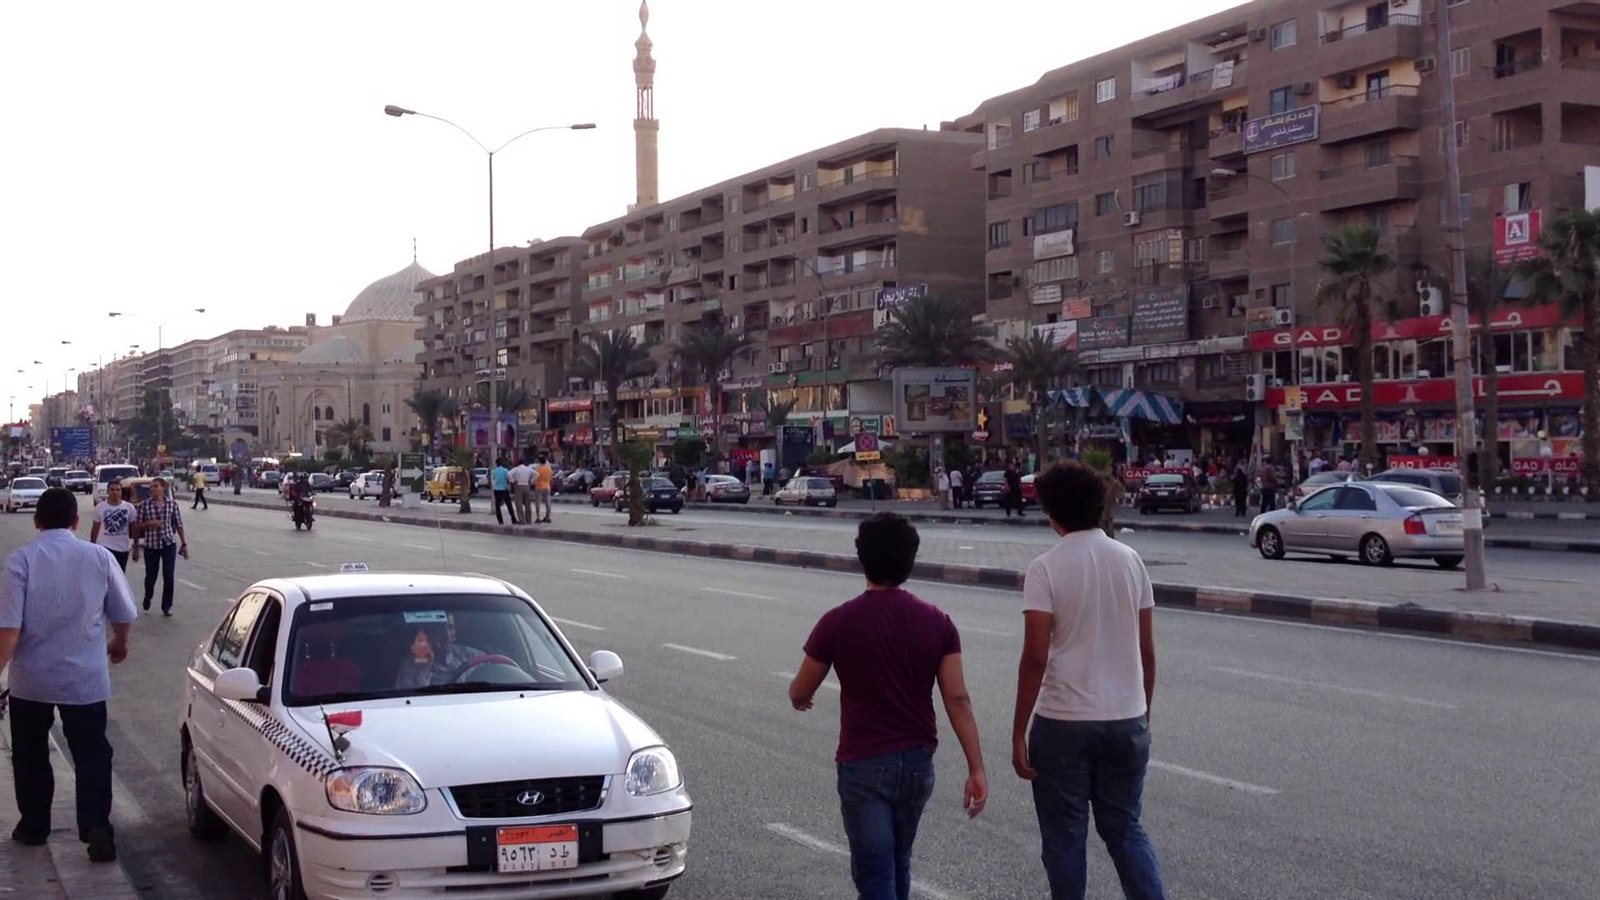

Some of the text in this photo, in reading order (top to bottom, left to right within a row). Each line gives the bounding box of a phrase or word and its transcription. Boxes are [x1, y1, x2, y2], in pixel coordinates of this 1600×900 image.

[1274, 328, 1342, 345] GAD
[1390, 461, 1414, 470] GAD
[1513, 461, 1538, 470] GAD
[1126, 470, 1150, 478] GAD
